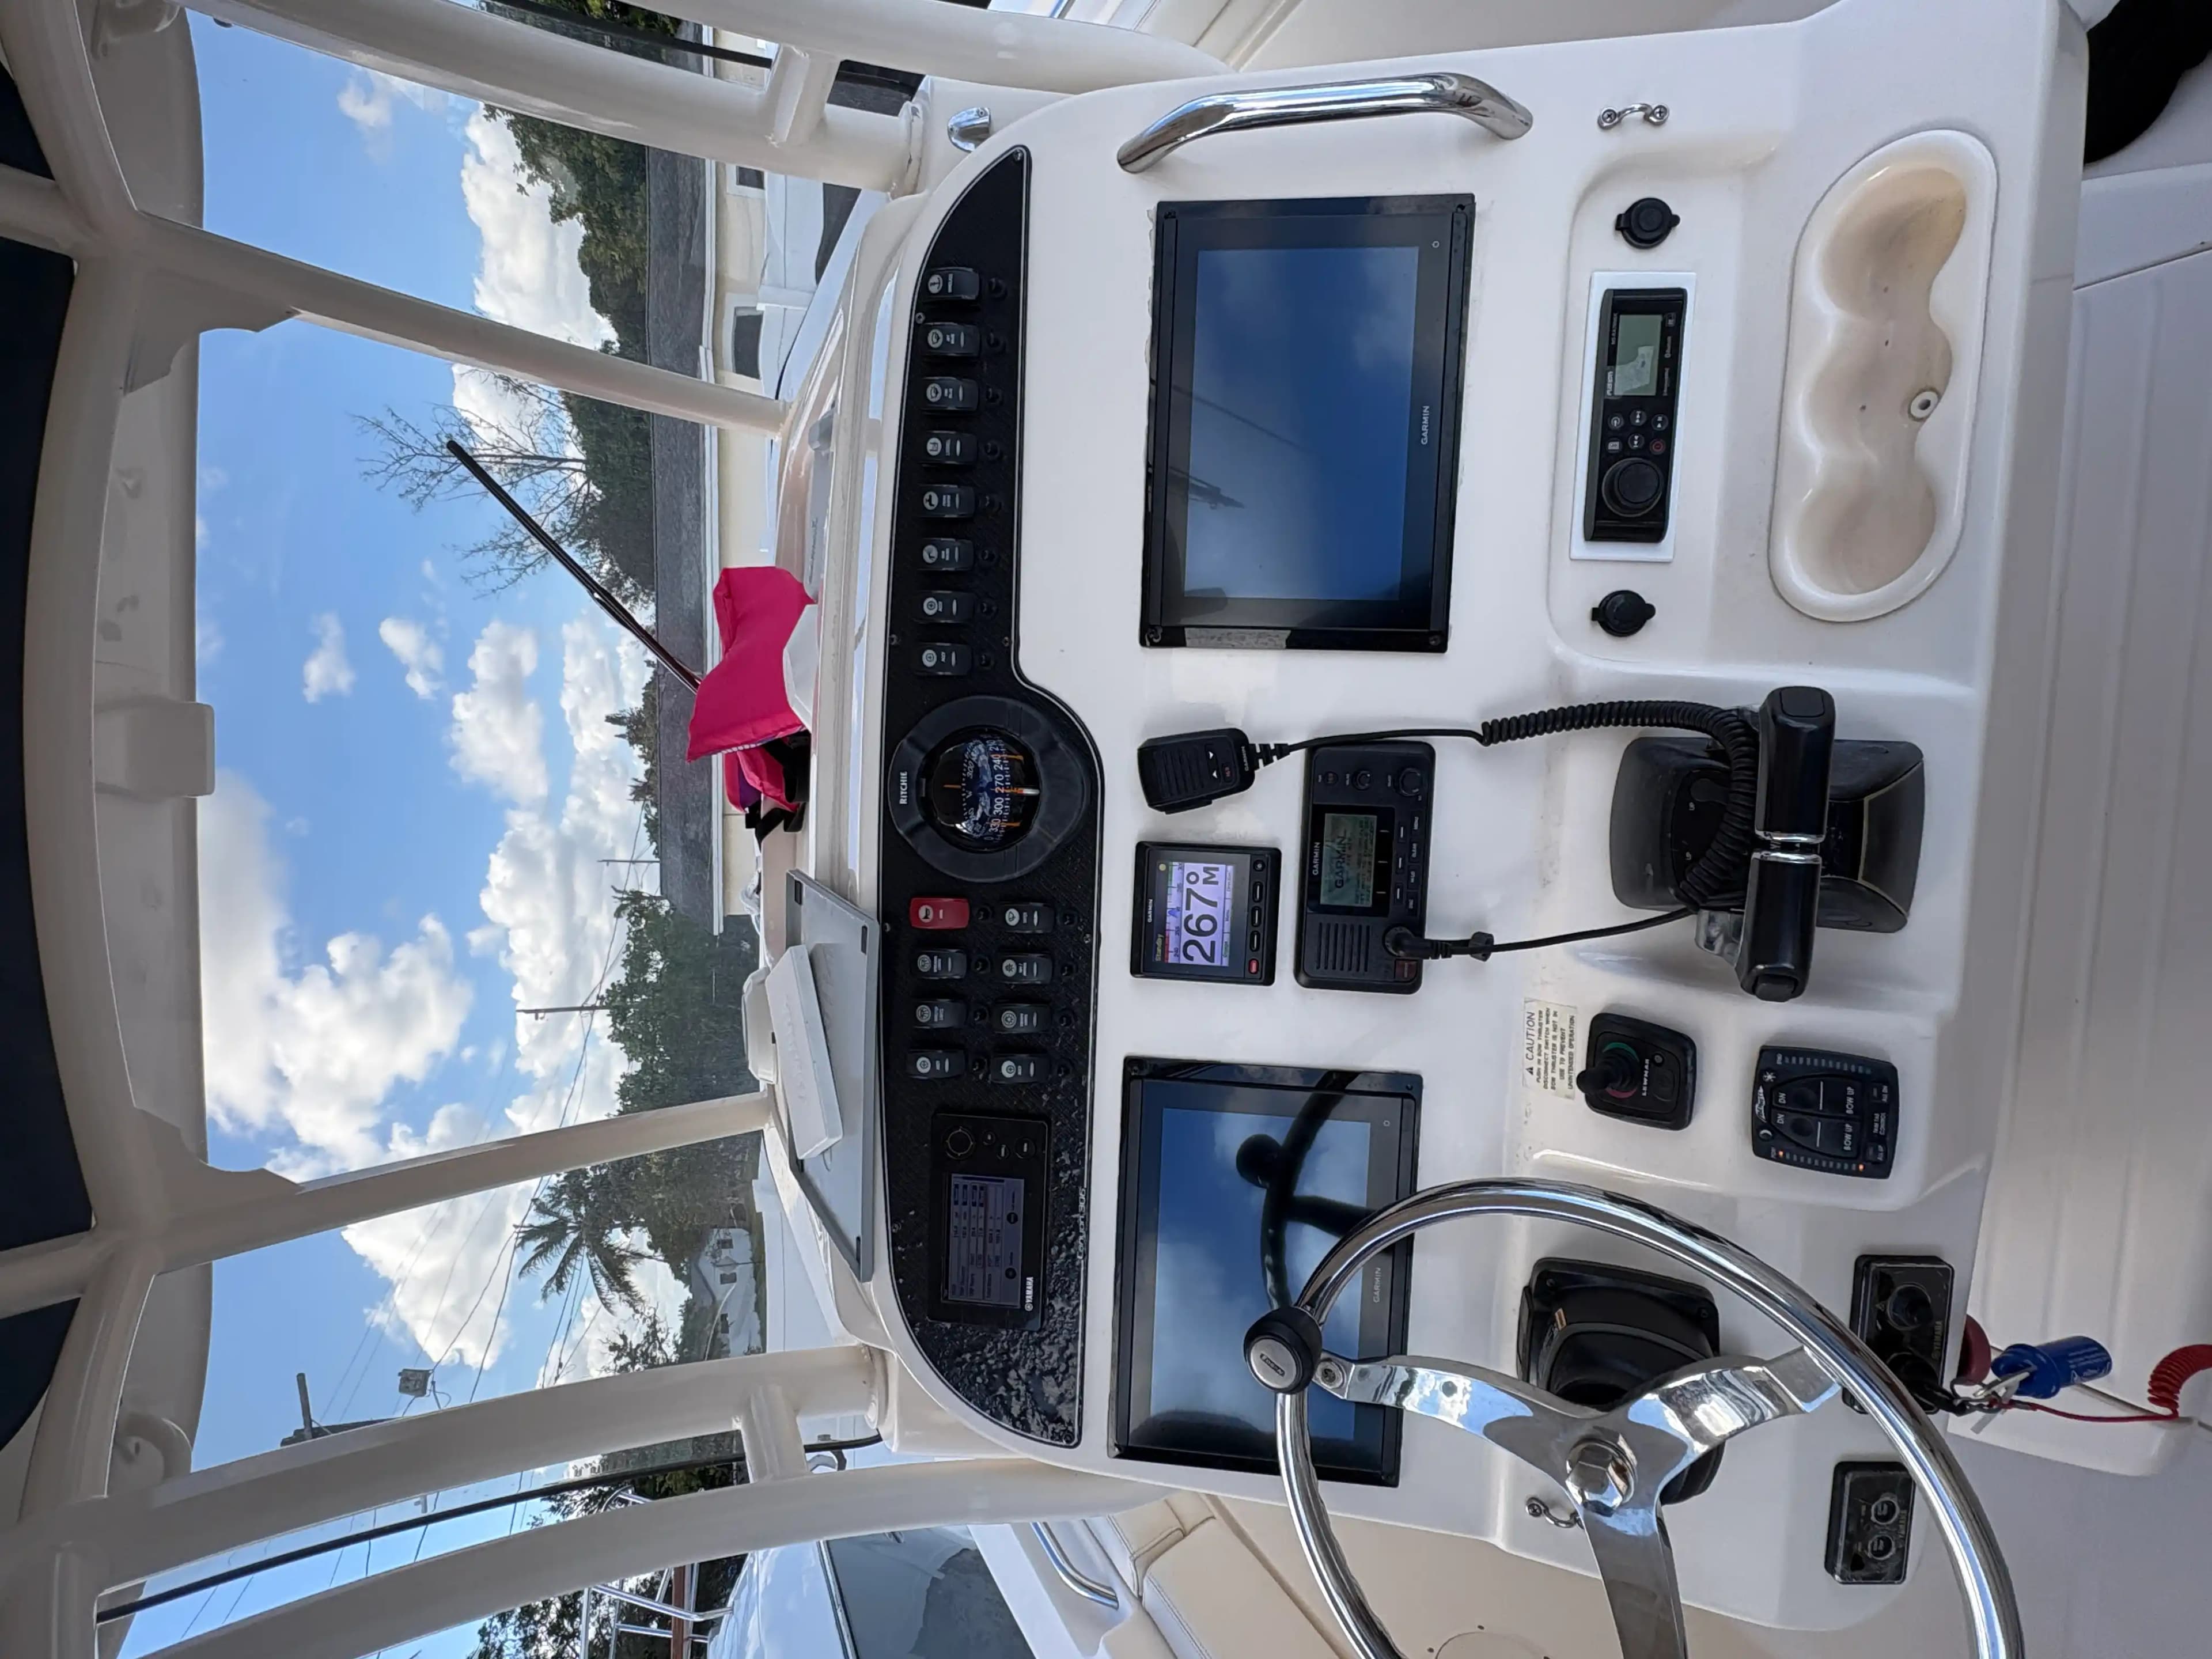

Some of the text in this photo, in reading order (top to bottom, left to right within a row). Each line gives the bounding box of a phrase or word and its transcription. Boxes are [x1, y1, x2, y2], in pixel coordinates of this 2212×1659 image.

[1421, 406, 1430, 445] GARMIN
[992, 754, 1003, 770] 240
[1241, 746, 1249, 771] GARMIN
[899, 771, 908, 804] RITCHIE
[994, 774, 1005, 793] 270
[993, 797, 1005, 815] 300
[1688, 802, 1695, 811] UP
[988, 819, 1001, 832] 330
[1312, 842, 1321, 875] GARMIN
[1335, 835, 1347, 889] GARMIN
[1685, 851, 1692, 861] UP
[1525, 1012, 1535, 1060] CAUTION
[1642, 1059, 1650, 1096] LEWMAR
[1778, 1092, 1787, 1104] DN
[1846, 1086, 1855, 1115] BOW UP
[1777, 1113, 1785, 1124] DN
[1843, 1123, 1853, 1151] BOW UP
[1077, 1188, 1086, 1259] Canyon 306
[1025, 1277, 1033, 1302] YAMAHA
[1373, 1267, 1381, 1303] GARMIN
